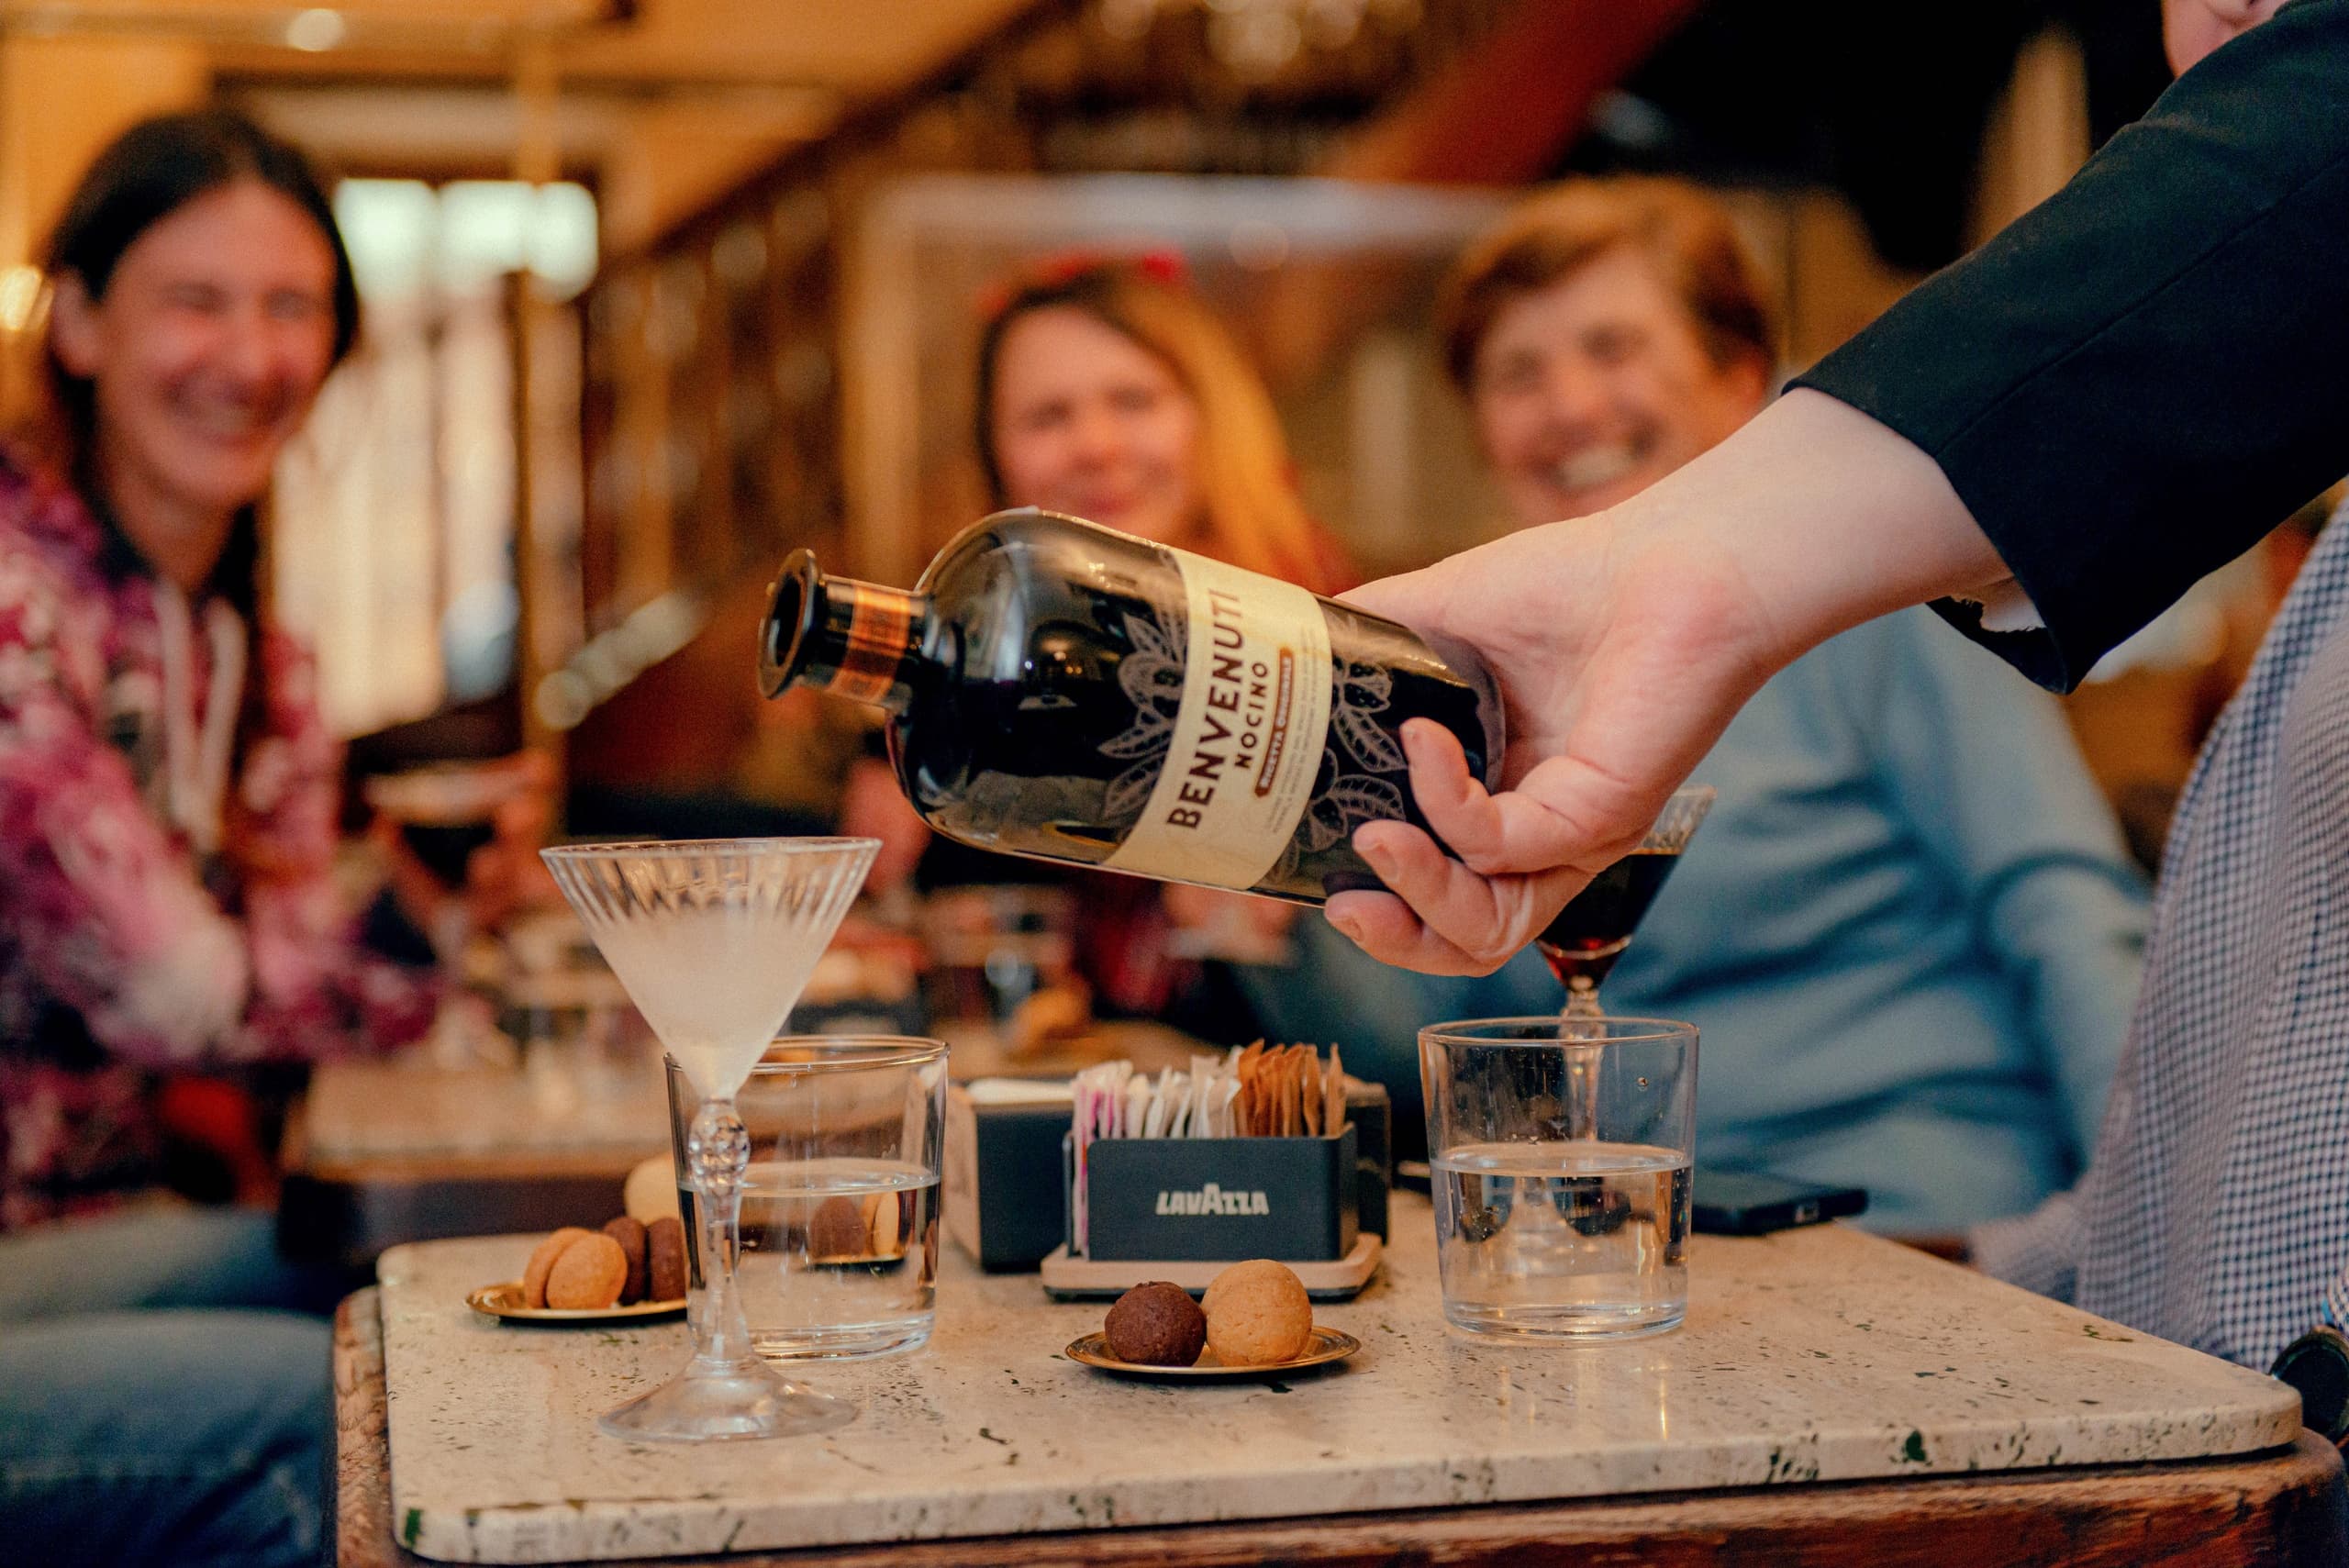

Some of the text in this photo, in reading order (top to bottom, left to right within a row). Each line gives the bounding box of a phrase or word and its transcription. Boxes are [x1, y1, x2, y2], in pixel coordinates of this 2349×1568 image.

[1166, 588, 1242, 829] BENVENUTI
[1234, 662, 1269, 769] NOCINO
[1156, 1183, 1270, 1216] LAVAZZA
